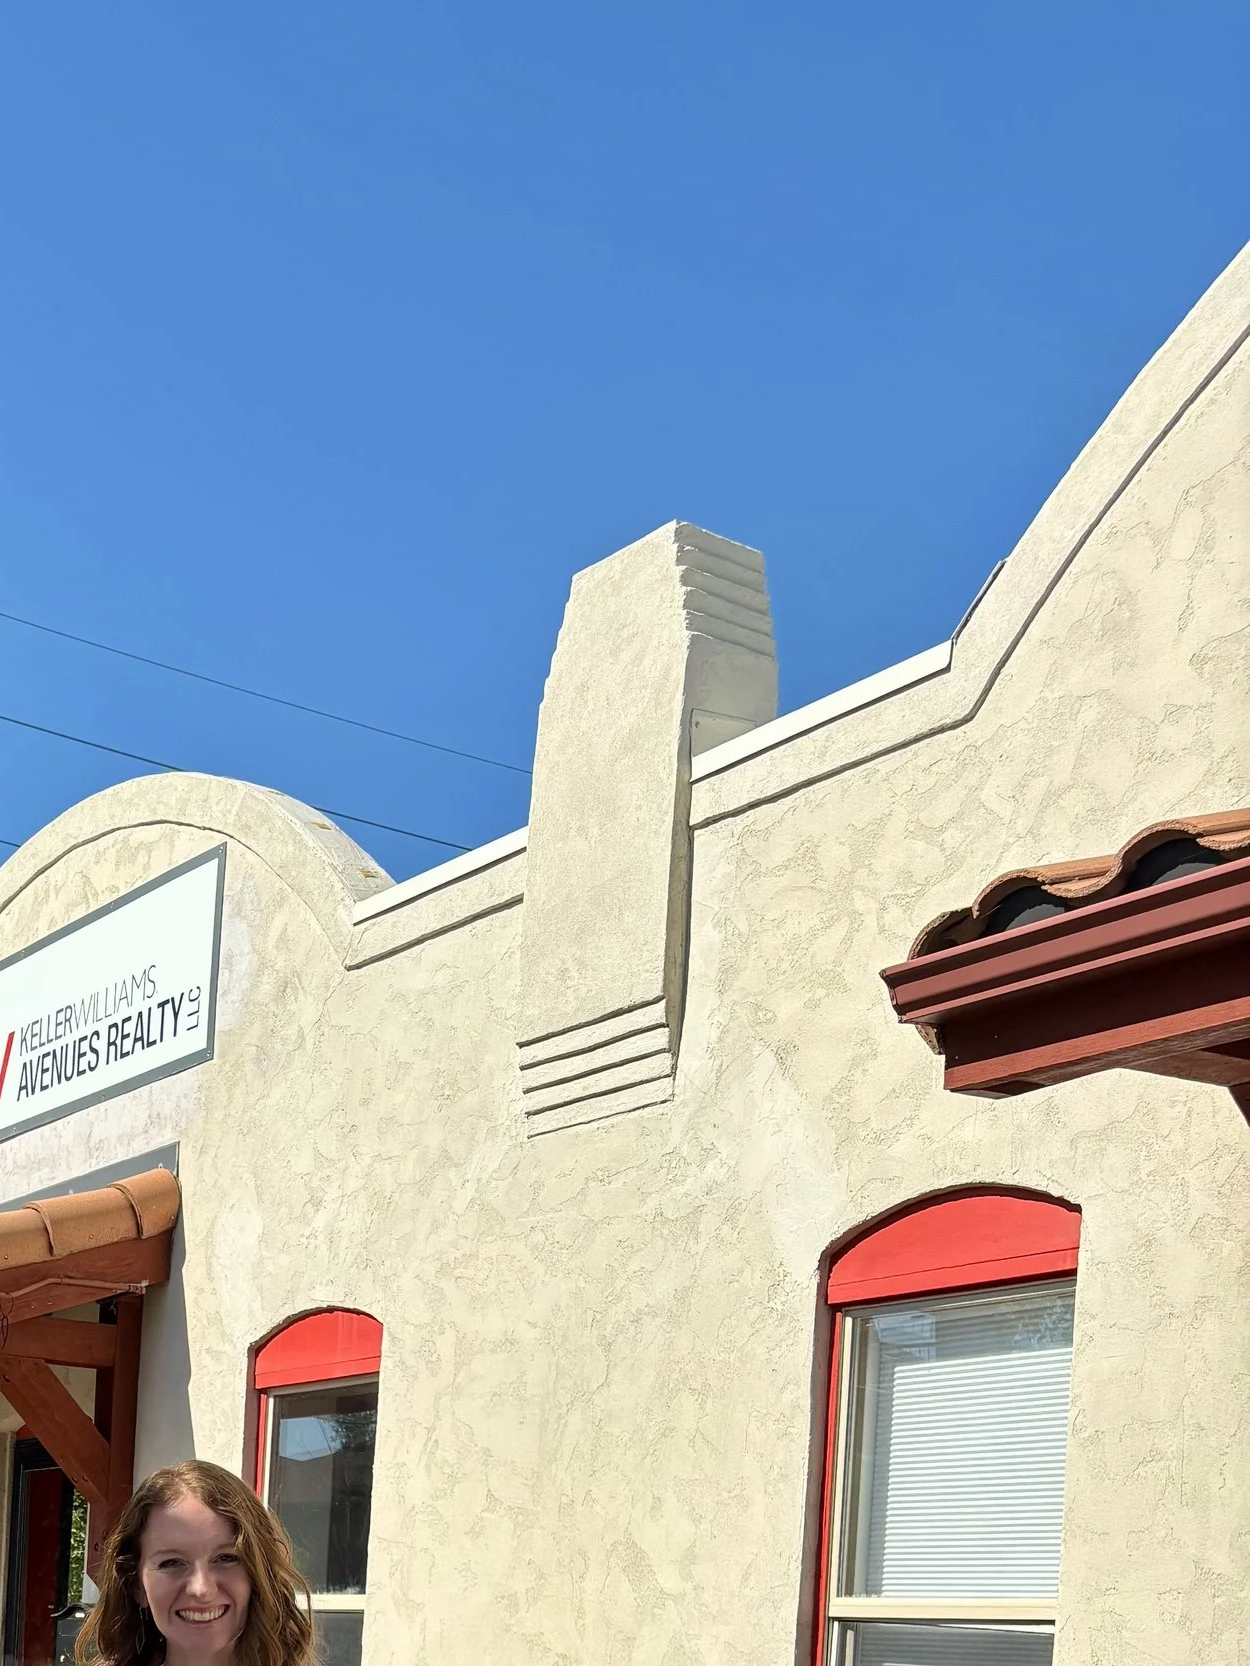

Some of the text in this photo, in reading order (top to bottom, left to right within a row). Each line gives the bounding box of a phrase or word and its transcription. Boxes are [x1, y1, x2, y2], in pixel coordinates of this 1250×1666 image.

[17, 991, 185, 1103] AVENUES REALTY
[186, 985, 202, 1032] LLC
